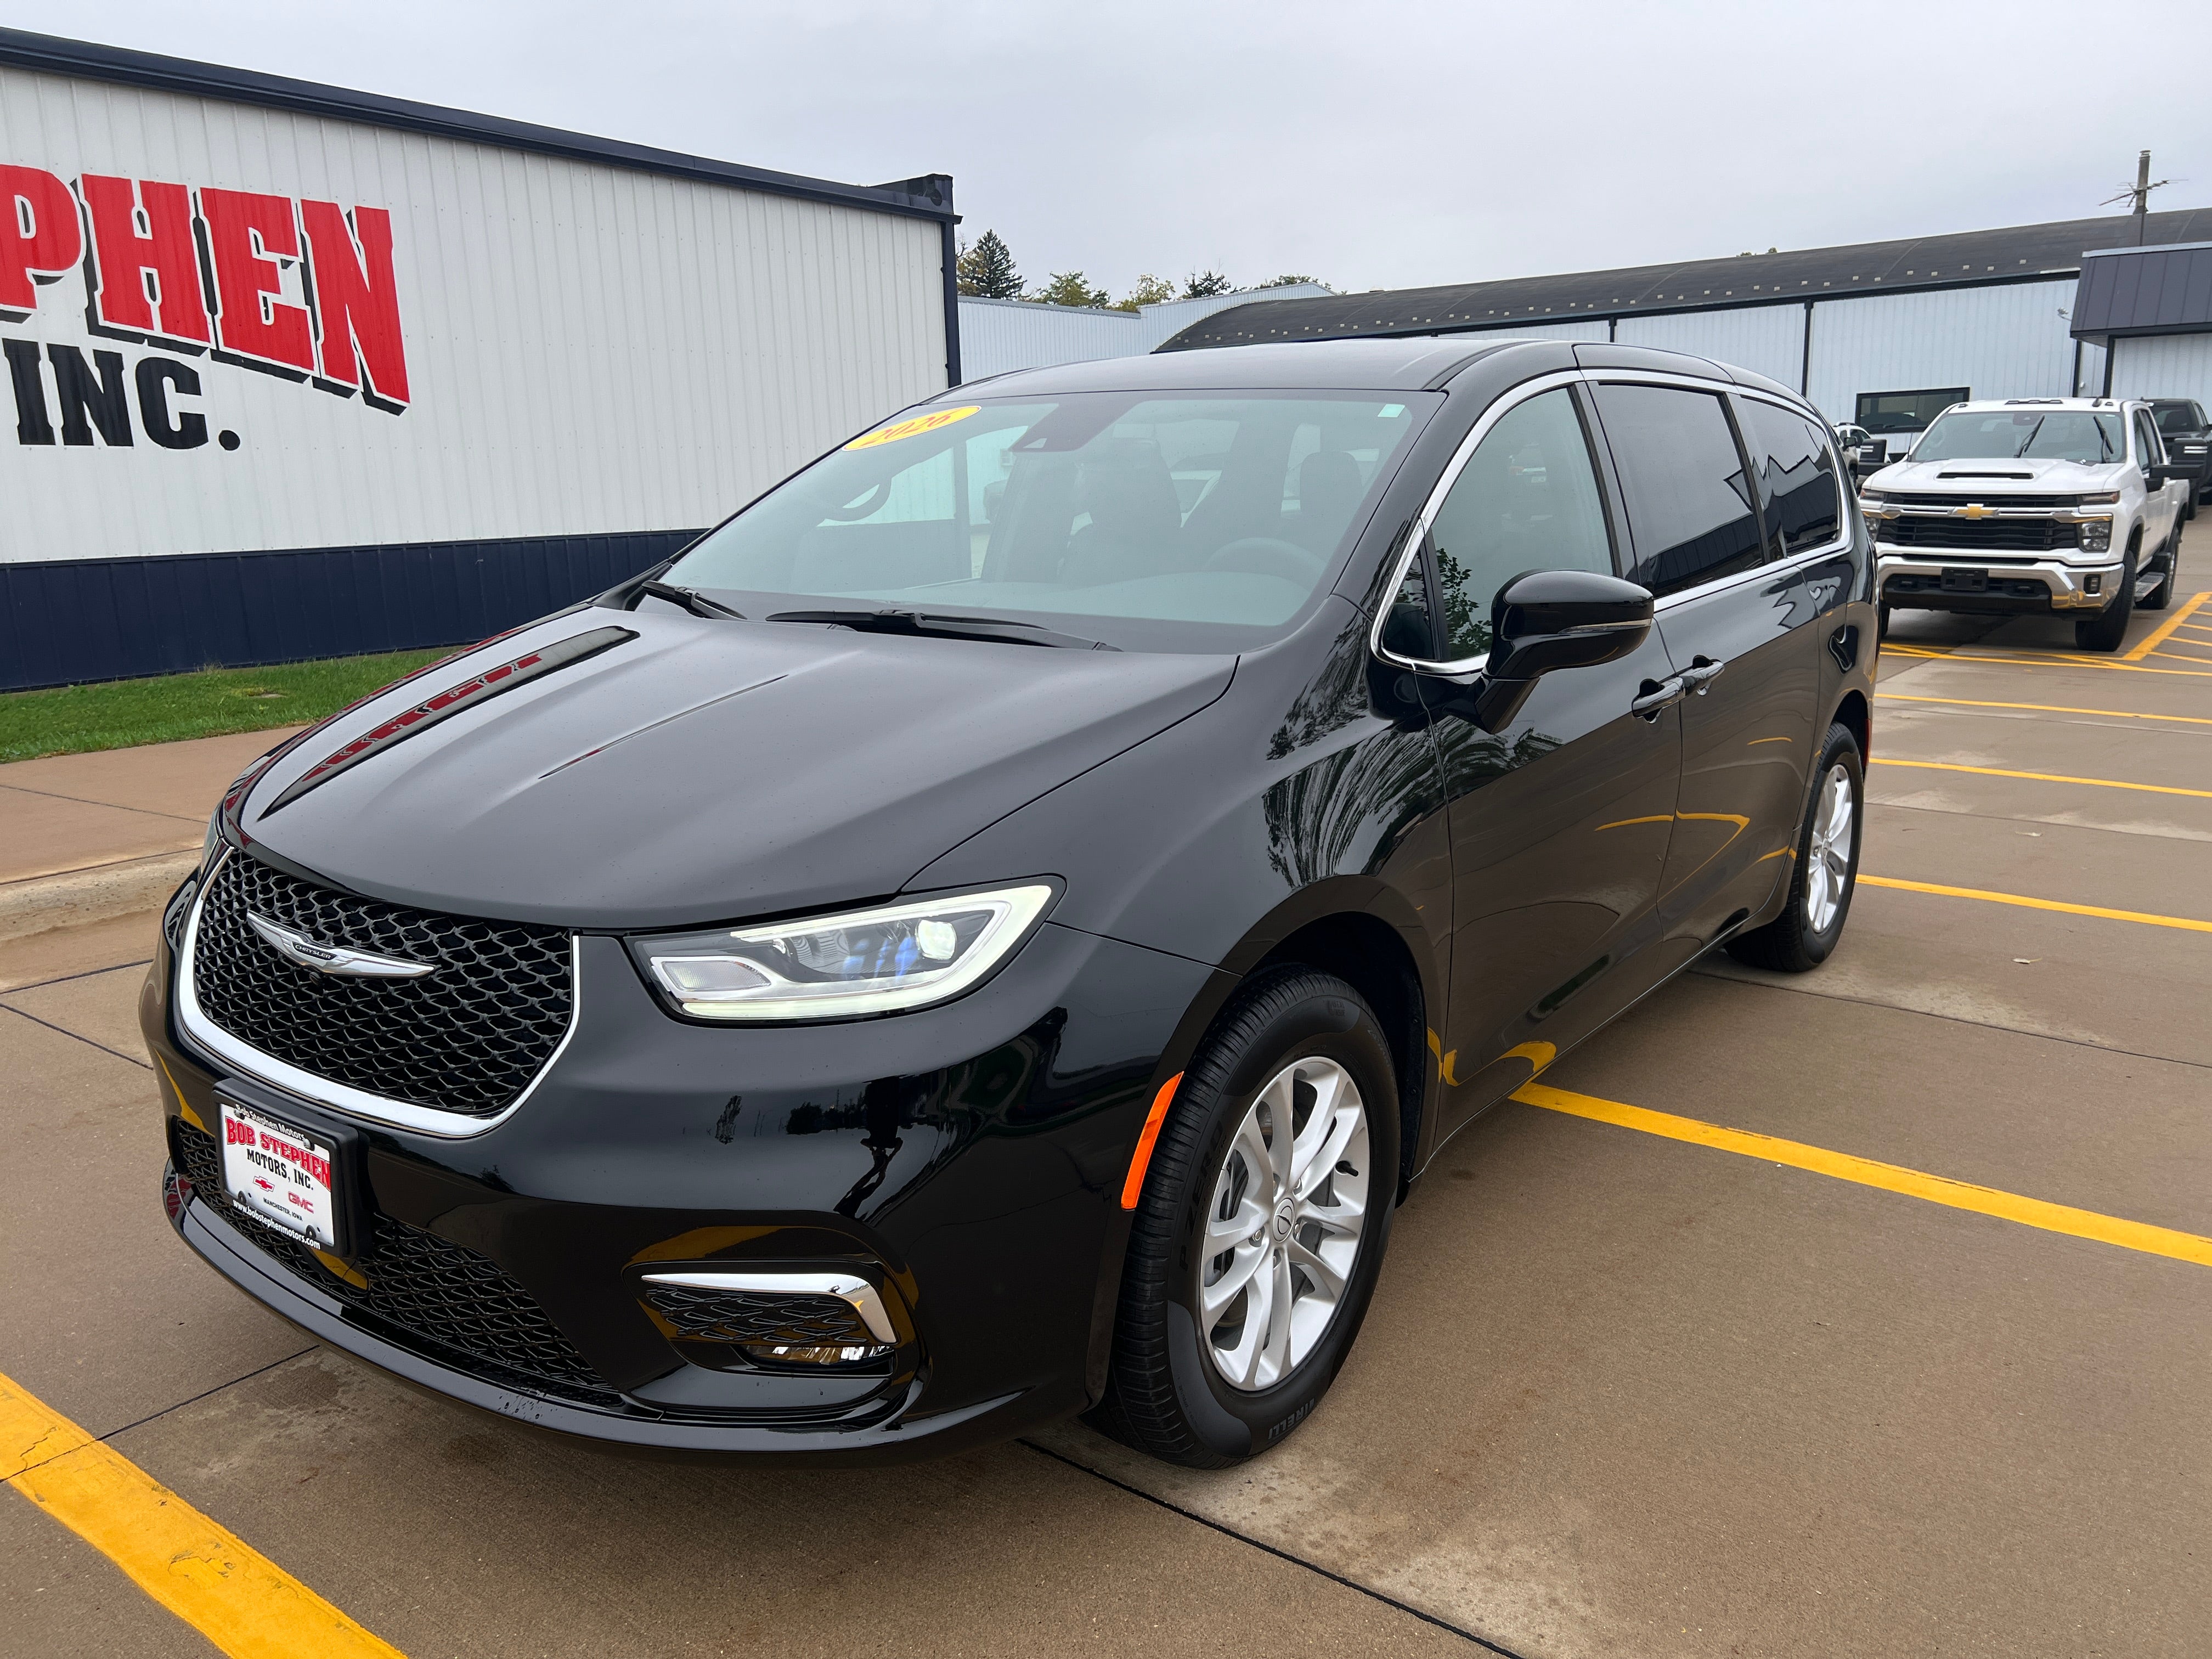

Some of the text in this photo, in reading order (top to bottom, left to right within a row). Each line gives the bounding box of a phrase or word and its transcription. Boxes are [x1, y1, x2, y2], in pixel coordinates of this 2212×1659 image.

[2, 338, 241, 451] INC.
[858, 408, 962, 447] 2026
[295, 944, 332, 960] CHRYSLER
[250, 1111, 279, 1131] Stephen
[279, 1124, 305, 1141] Motors
[225, 1116, 331, 1192] BOB STEPHEN
[247, 1149, 314, 1190] MOTORS, INC.
[263, 1197, 291, 1217] MANCHESTER,
[287, 1191, 314, 1214] GMC
[233, 1199, 321, 1250] www.bobstephenmotors.com
